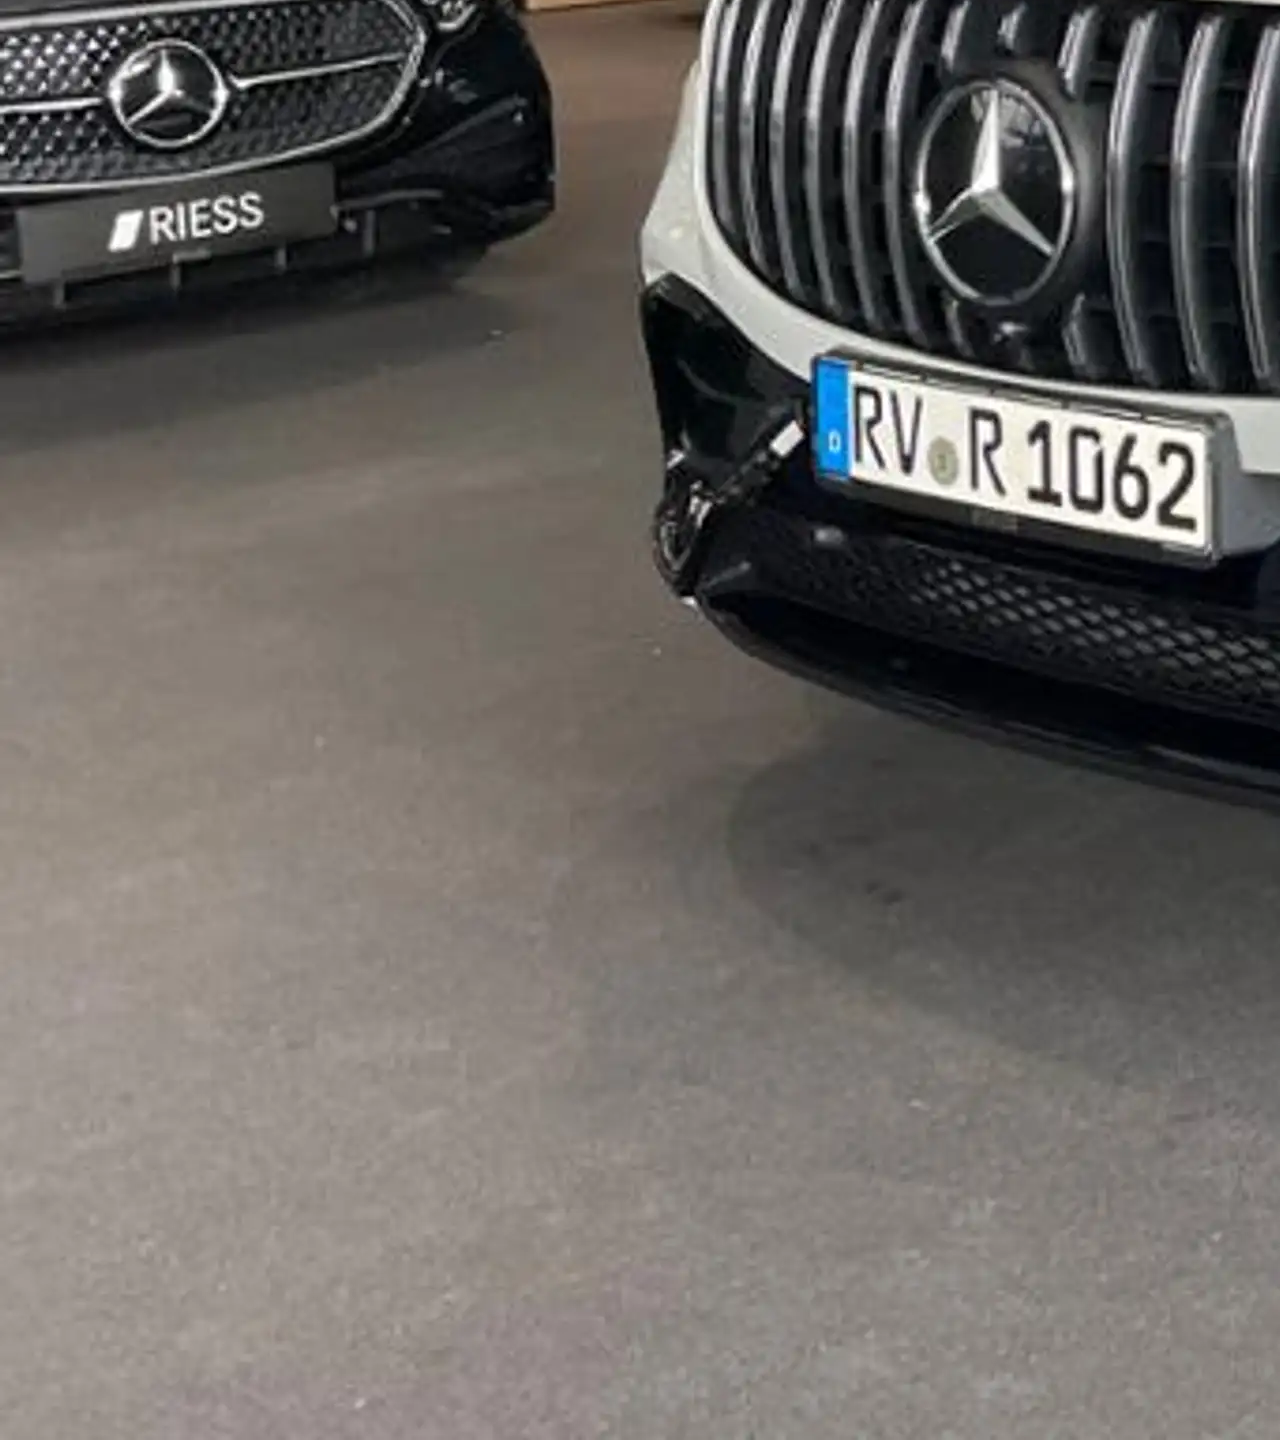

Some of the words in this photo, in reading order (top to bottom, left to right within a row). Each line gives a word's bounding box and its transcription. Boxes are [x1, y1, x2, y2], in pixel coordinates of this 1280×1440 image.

[149, 190, 265, 245] RIESS
[828, 430, 842, 454] D
[853, 385, 923, 475] RV
[969, 407, 1007, 497] R
[1027, 419, 1199, 533] 1062
